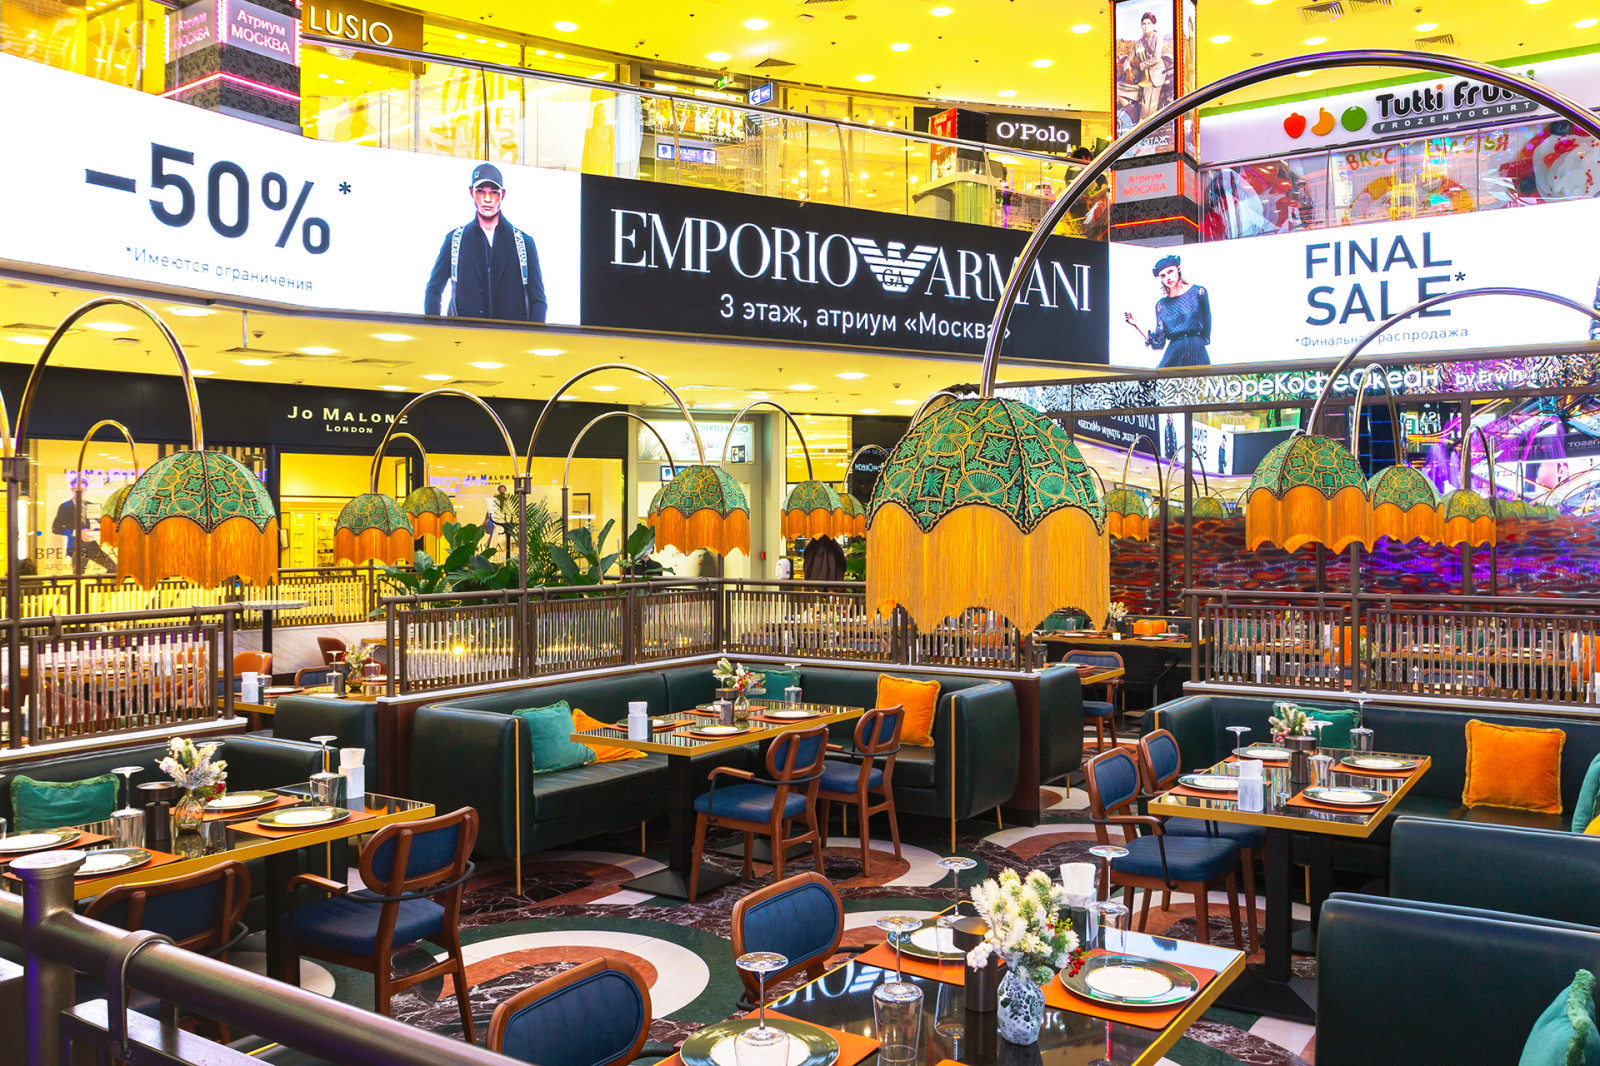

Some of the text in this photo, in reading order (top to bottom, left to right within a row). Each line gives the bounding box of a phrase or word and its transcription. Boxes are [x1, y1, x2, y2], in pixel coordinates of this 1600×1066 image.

[236, 8, 286, 37] Атриум
[310, 5, 393, 46] LUSIO
[231, 23, 291, 55] МОСКВА
[1375, 69, 1535, 119] Tutti Fru
[996, 121, 1070, 143] O'Polo
[1345, 147, 1396, 170] ВКУС
[1124, 182, 1167, 196] МОСКВА
[1128, 172, 1163, 185] Атриум
[611, 208, 858, 287] EMPORIO
[924, 246, 1091, 311] ARMANI
[1305, 231, 1453, 279] FINAL
[215, 264, 313, 292] ограничения
[720, 293, 734, 318] 3
[743, 301, 808, 328] этаж,
[816, 307, 897, 336] атриум
[1295, 328, 1468, 348] Финальна распродажа
[1455, 370, 1476, 387] by
